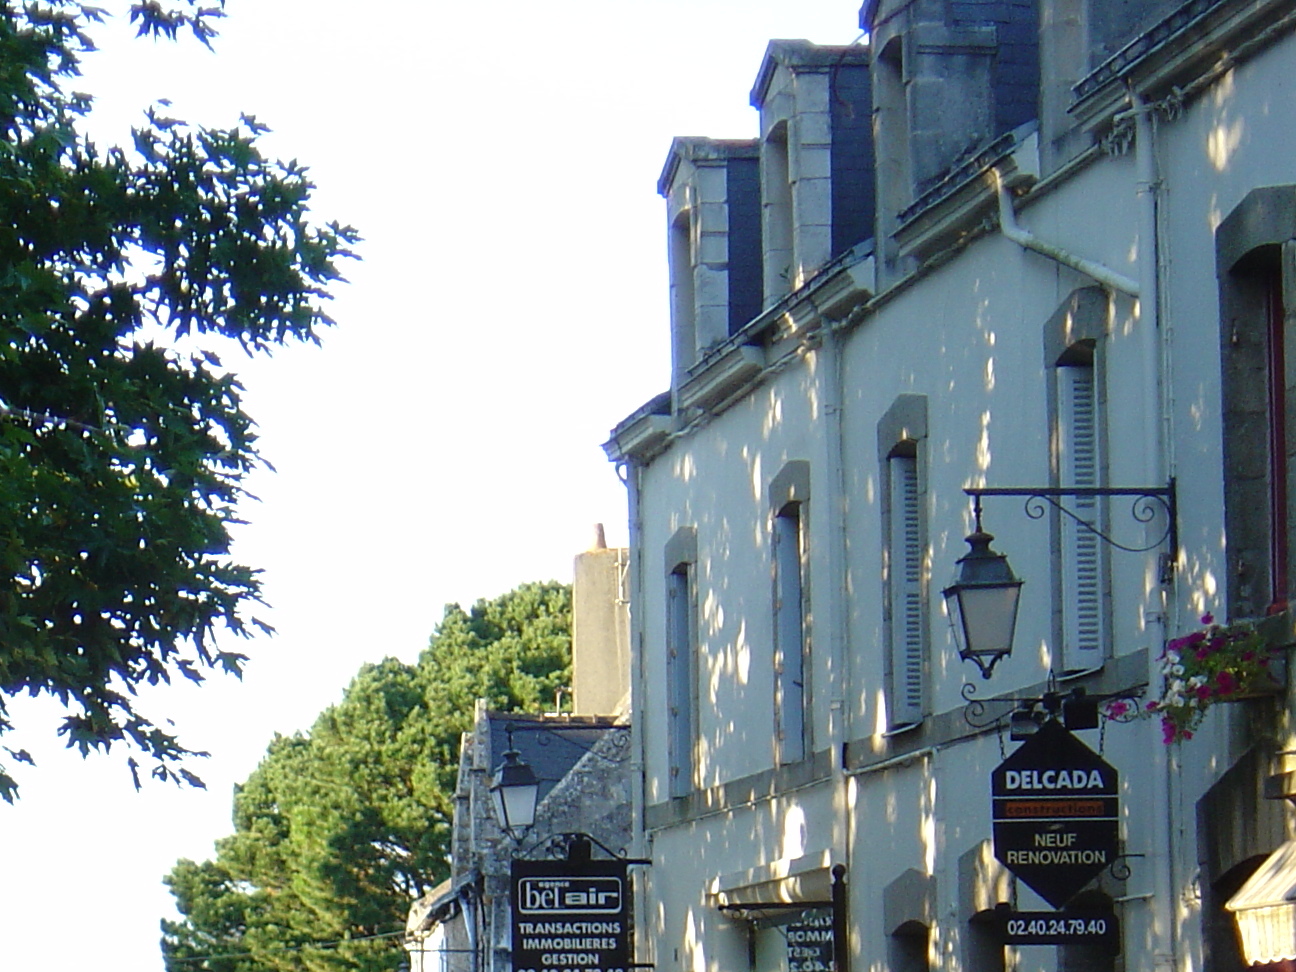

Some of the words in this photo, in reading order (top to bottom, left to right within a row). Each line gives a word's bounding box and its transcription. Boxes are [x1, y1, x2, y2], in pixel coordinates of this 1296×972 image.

[1005, 770, 1104, 789] DELCADA
[1007, 801, 1103, 815] constructions
[1034, 833, 1077, 847] NEUF
[1007, 850, 1106, 864] RENOVATION
[526, 882, 559, 909] bel
[565, 887, 619, 905] air
[518, 922, 621, 934] TRANSACTIONS
[1007, 919, 1106, 935] 02.40.24.79.40
[523, 938, 617, 950] IMMOBILIERES
[541, 953, 599, 965] GESTION
